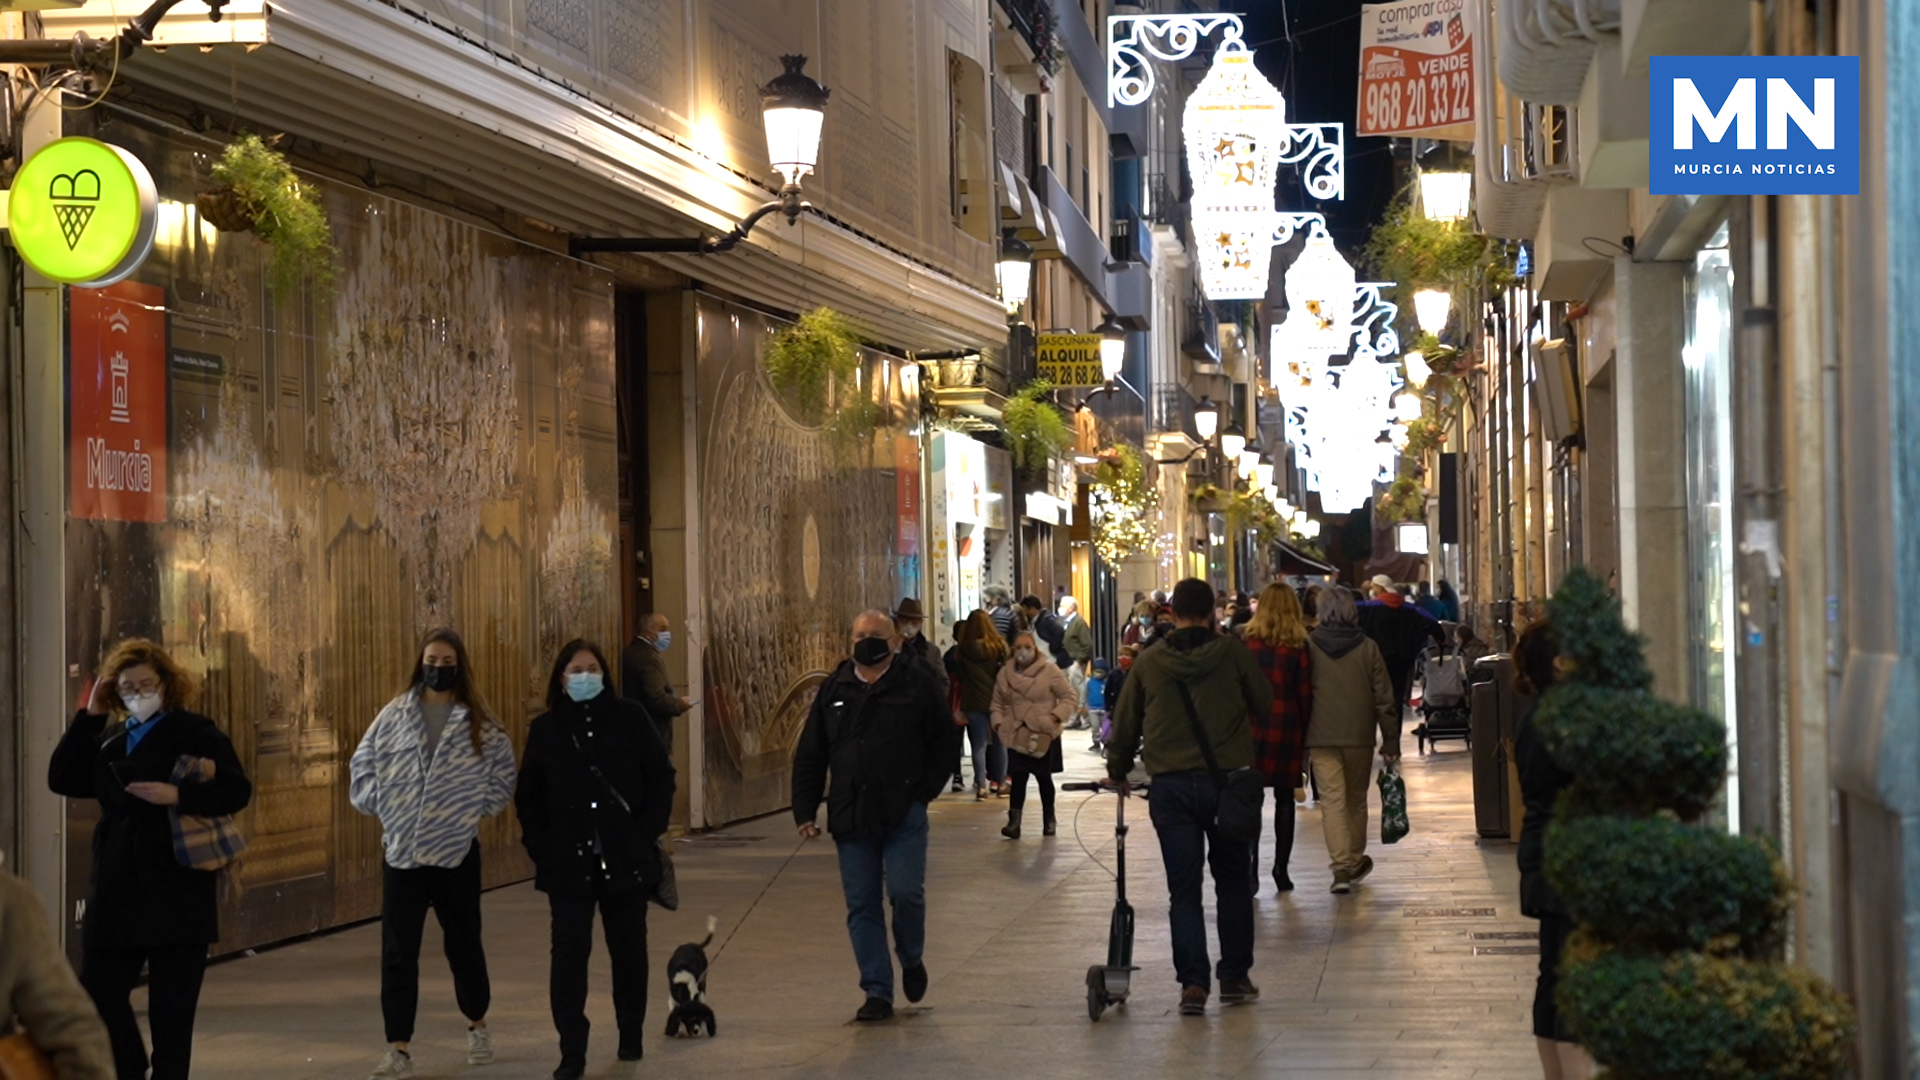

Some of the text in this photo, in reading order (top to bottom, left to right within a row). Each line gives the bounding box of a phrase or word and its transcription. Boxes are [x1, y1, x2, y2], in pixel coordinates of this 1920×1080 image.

[1418, 53, 1469, 76] VENDE
[1366, 70, 1470, 131] 968 20 33 22
[1039, 349, 1102, 362] ALQUILA
[1060, 365, 1072, 385] 28
[1076, 365, 1088, 385] 68
[1091, 365, 1104, 385] 28
[87, 437, 152, 493] Murcia
